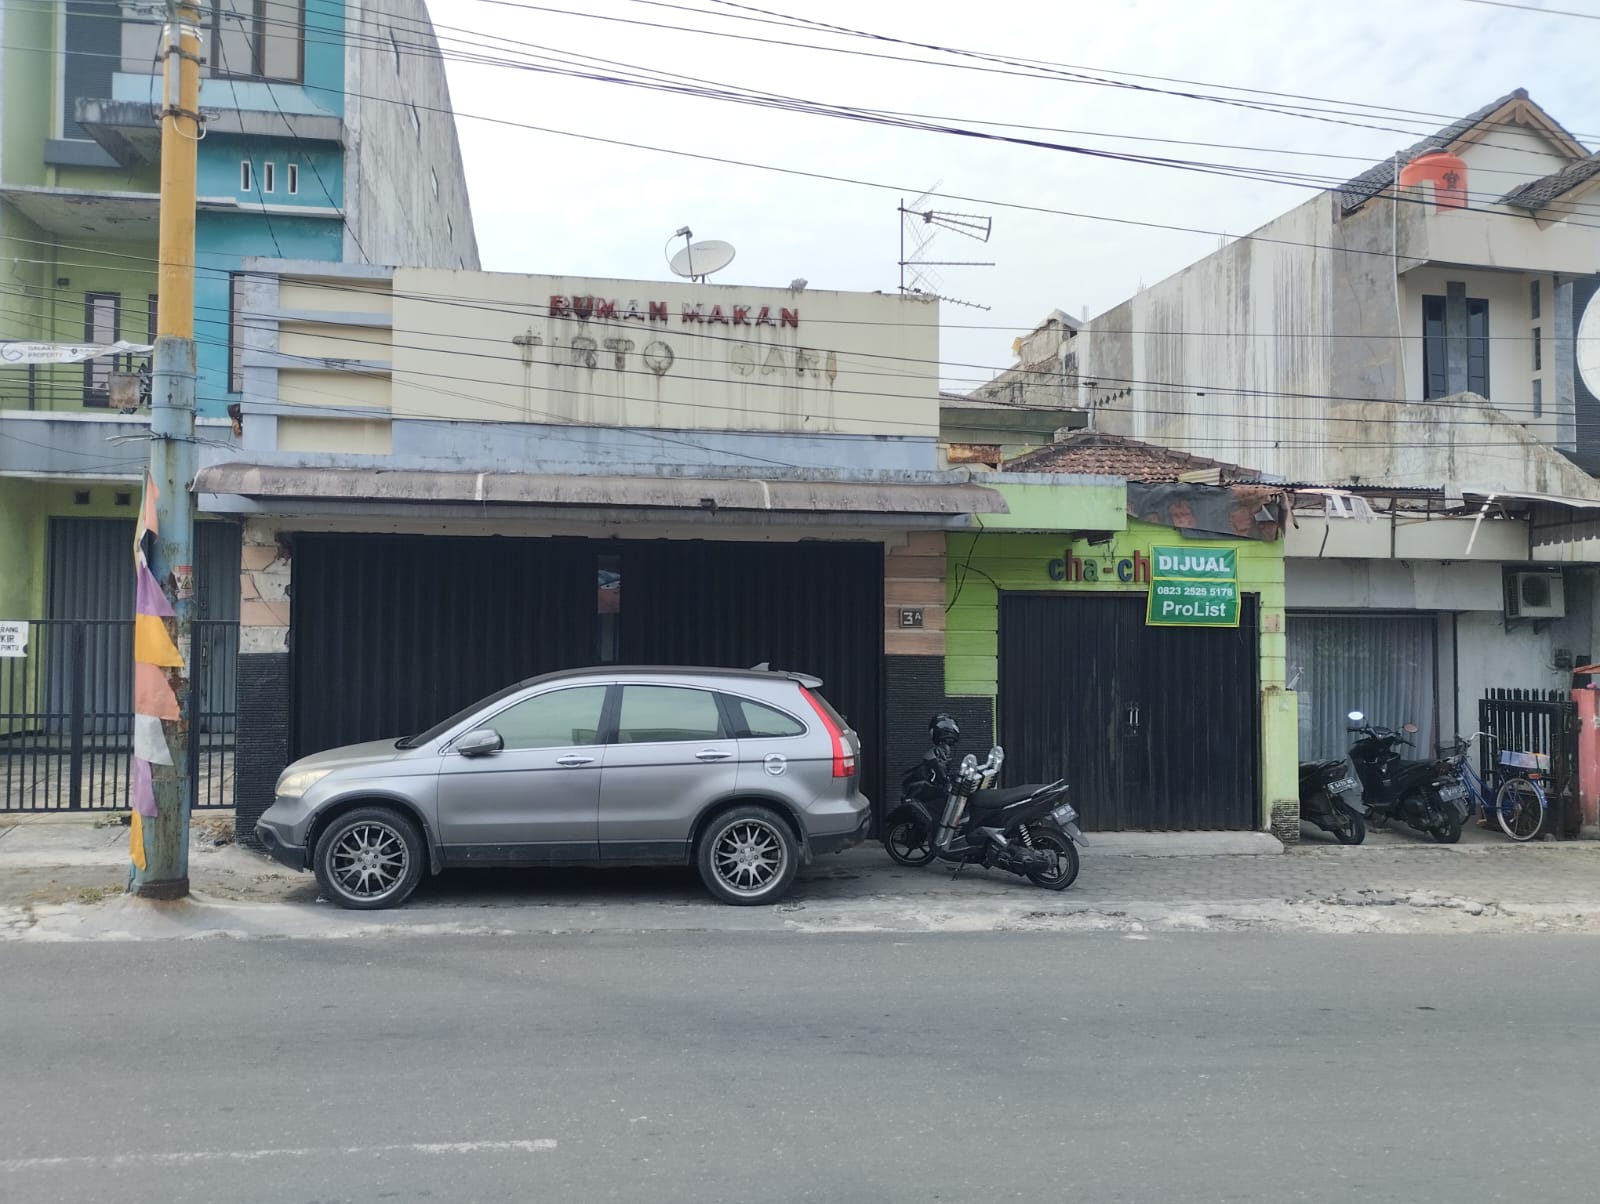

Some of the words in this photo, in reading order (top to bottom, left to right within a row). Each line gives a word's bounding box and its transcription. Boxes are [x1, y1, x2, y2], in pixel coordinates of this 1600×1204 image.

[682, 303, 799, 328] MAKAN
[1159, 555, 1230, 572] DIJUAL
[1157, 586, 1182, 595] 0823
[1184, 587, 1207, 596] 2525
[1209, 588, 1233, 597] 5178
[1162, 600, 1226, 617] ProList
